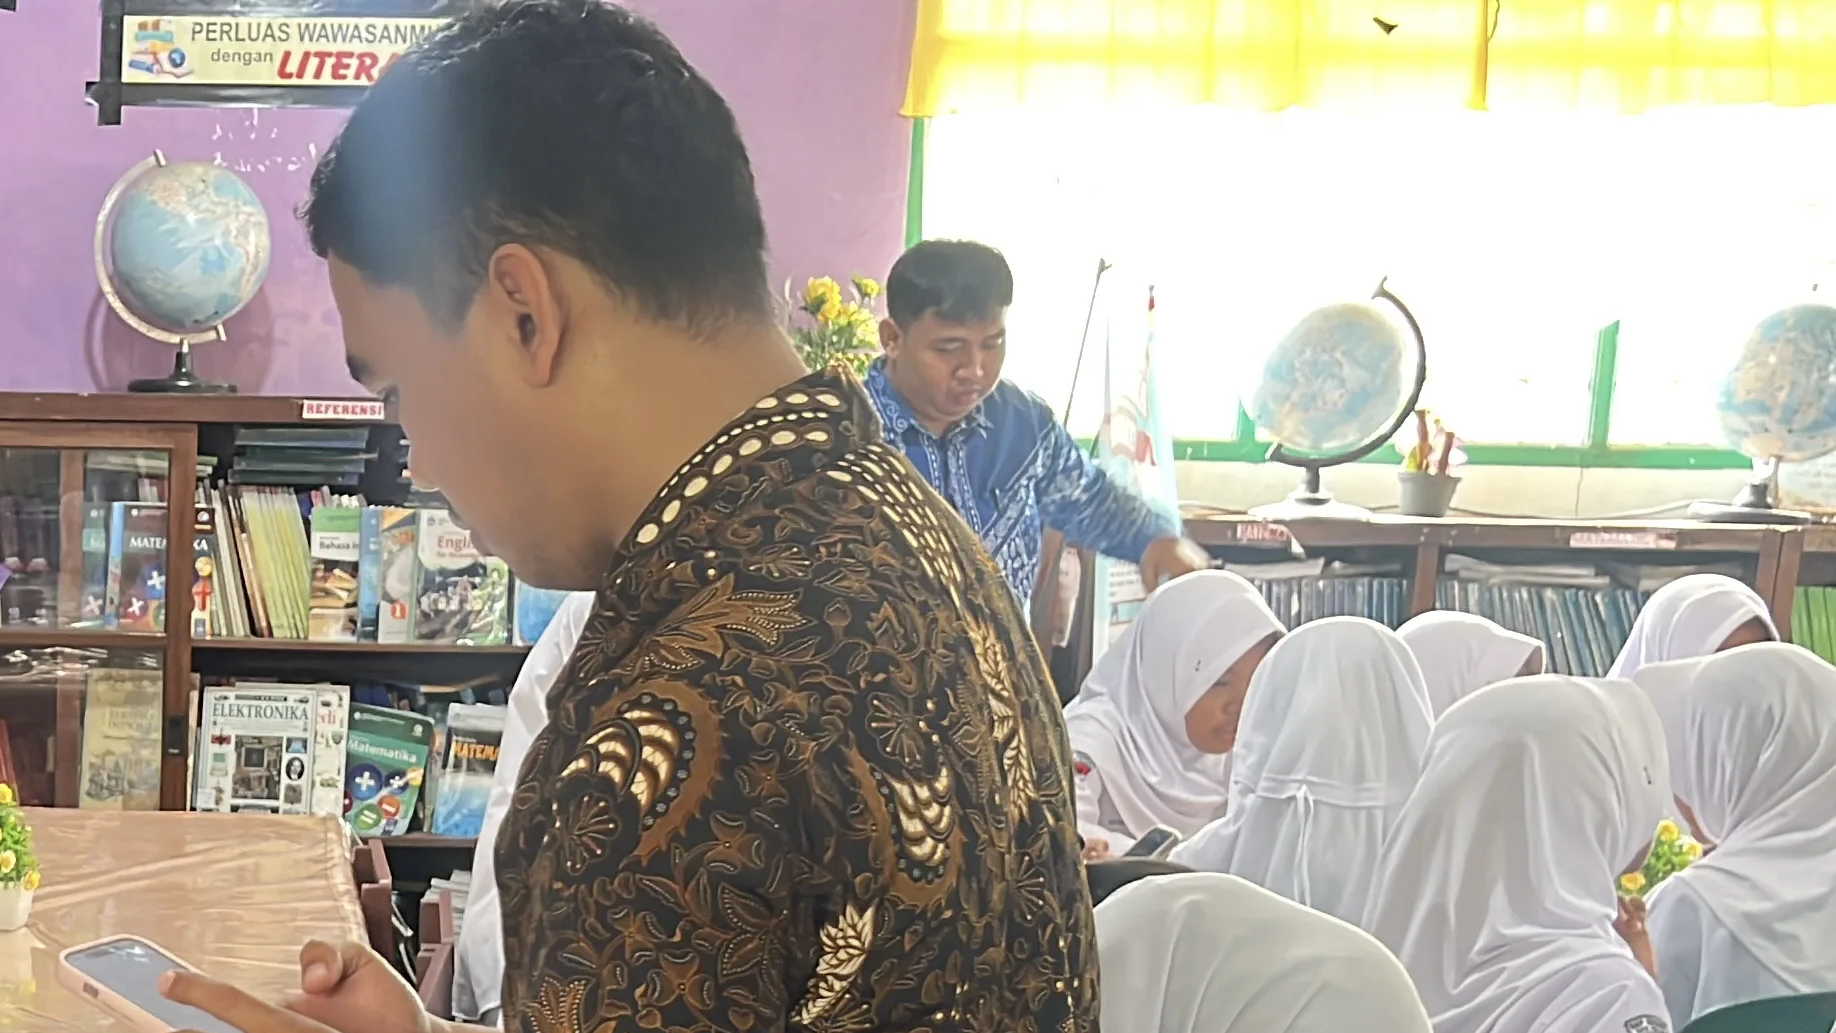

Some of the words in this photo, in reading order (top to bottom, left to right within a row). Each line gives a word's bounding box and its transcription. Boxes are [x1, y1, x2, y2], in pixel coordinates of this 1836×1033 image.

[191, 22, 290, 42] PERLUAS
[210, 49, 274, 66] dengan
[306, 403, 382, 416] REFERENSI
[319, 541, 350, 550] Bahasa
[213, 703, 309, 720] ELEKTRONIKA
[347, 738, 417, 763] Matematika
